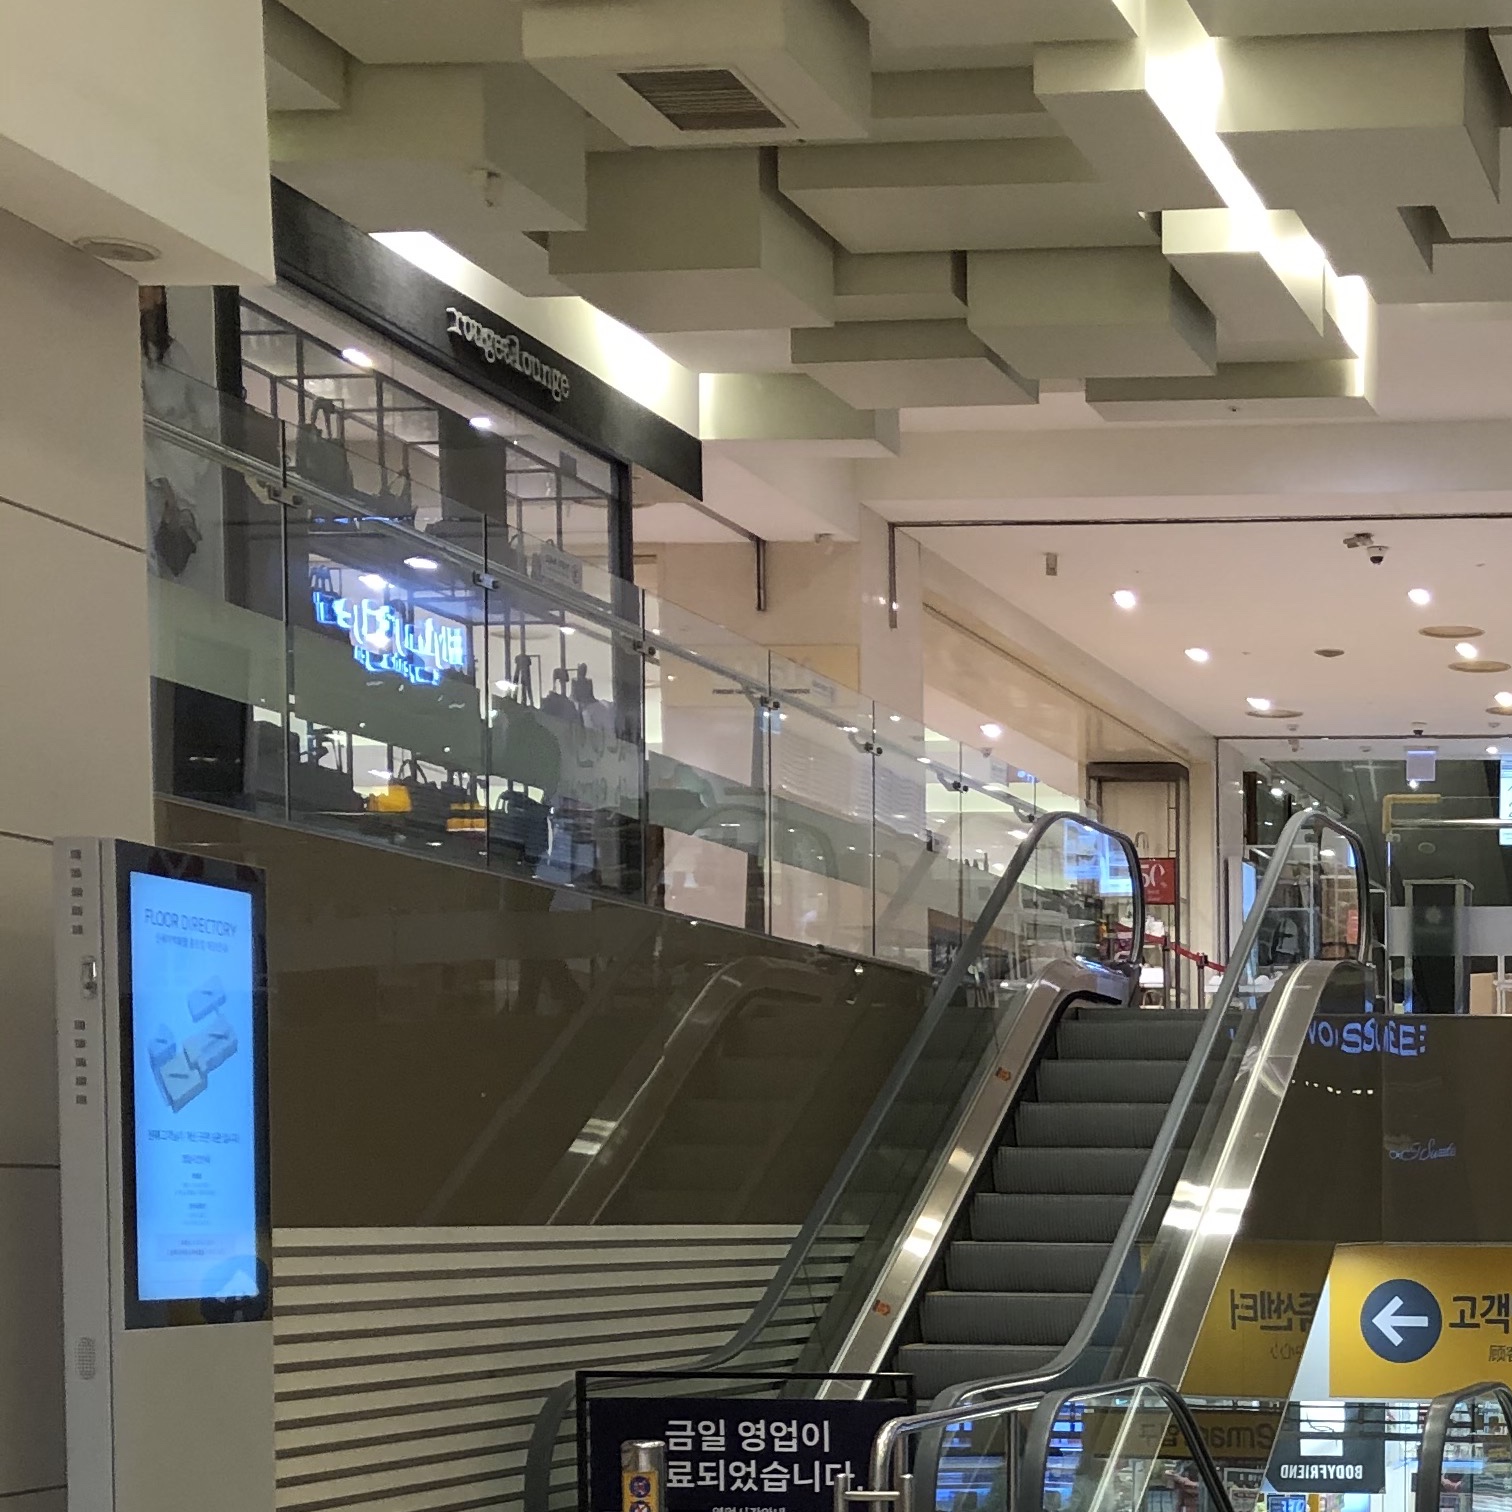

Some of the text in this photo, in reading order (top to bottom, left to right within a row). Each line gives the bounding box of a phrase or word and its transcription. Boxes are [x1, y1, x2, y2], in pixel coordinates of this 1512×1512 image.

[144, 908, 238, 938] FLOOR DIRECTORY
[665, 1419, 830, 1453] 금일 영업이
[666, 1459, 864, 1493] 료되었습니다.
